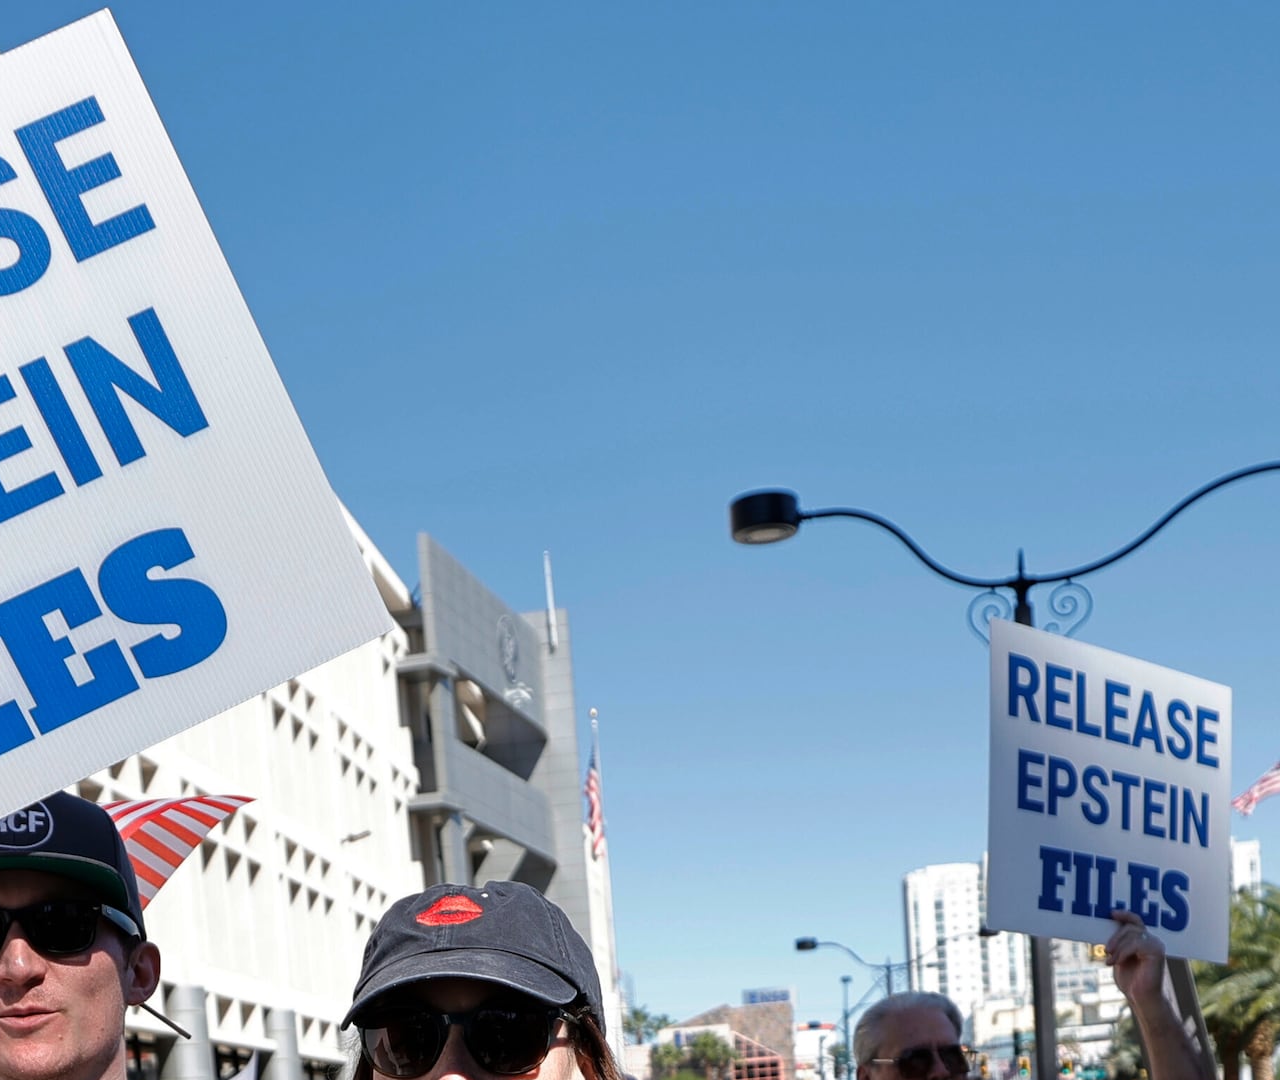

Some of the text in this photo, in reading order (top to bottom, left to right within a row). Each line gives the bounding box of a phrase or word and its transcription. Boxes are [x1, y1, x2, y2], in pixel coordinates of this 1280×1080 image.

[1008, 653, 1219, 768] RELEASE
[1018, 748, 1209, 848] EPSTEIN
[1037, 845, 1190, 932] FILES
